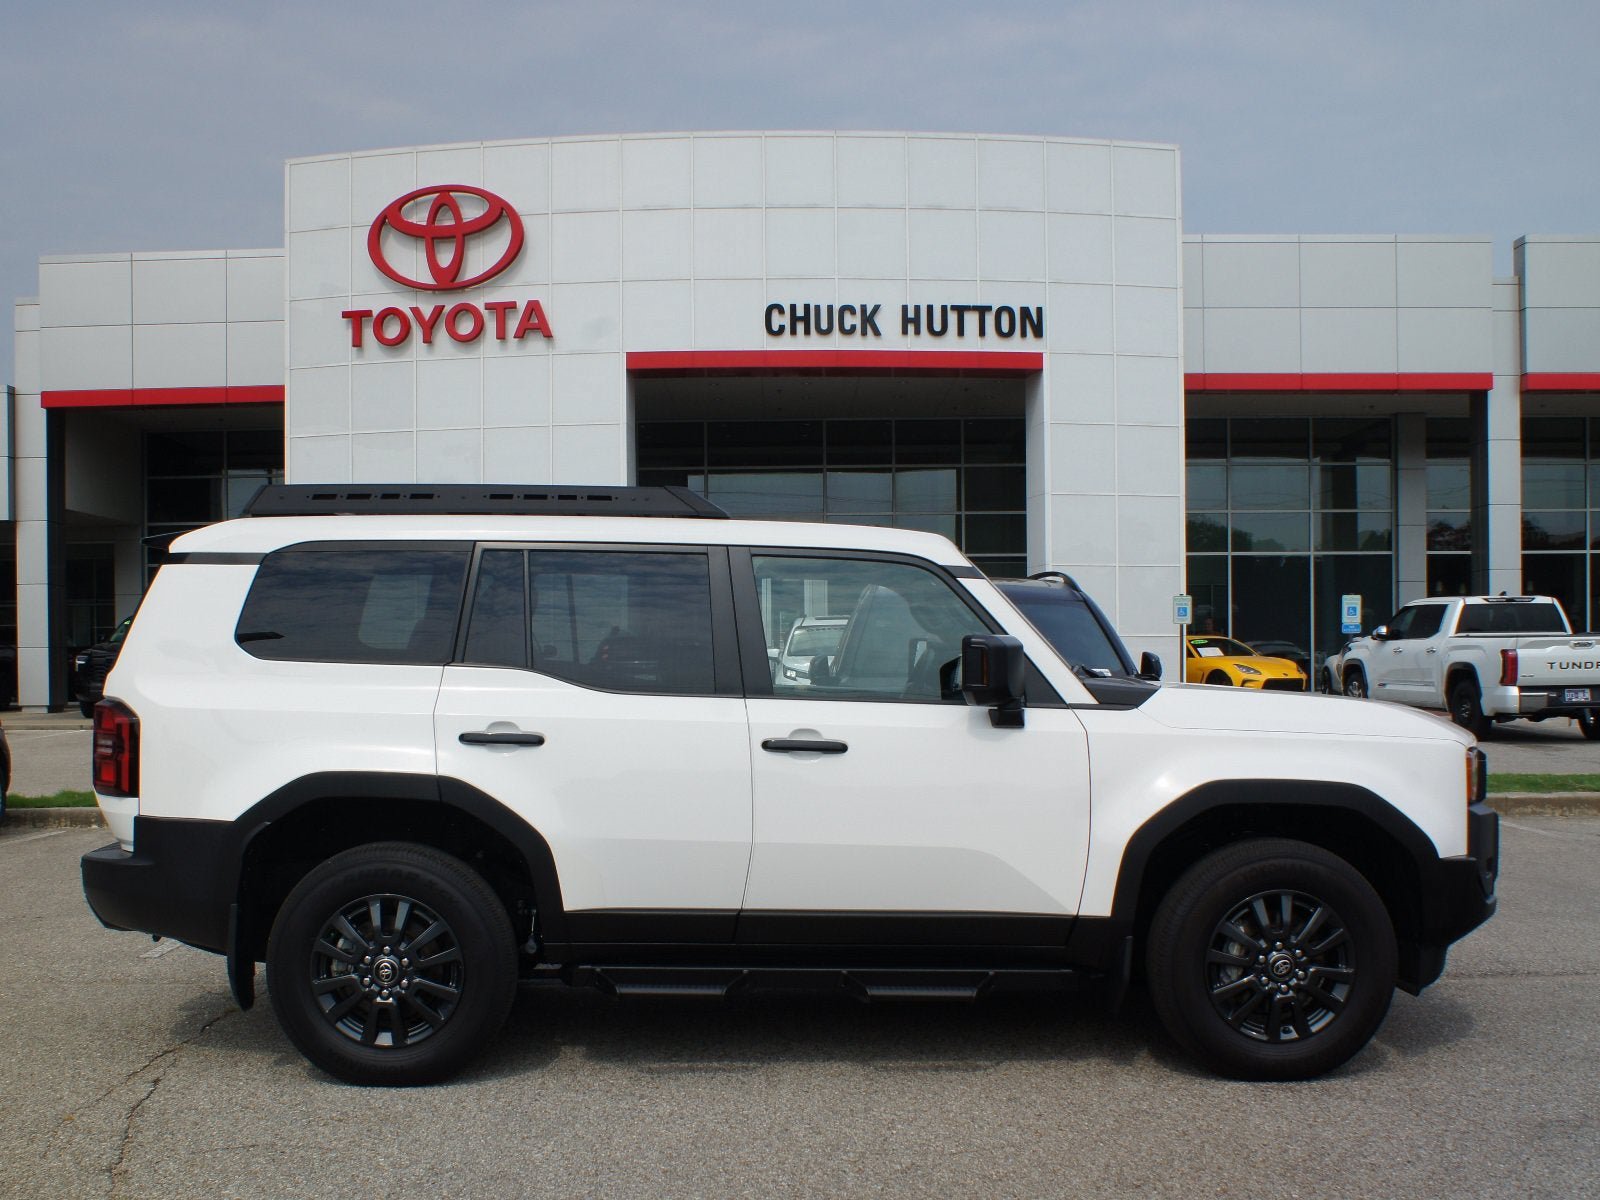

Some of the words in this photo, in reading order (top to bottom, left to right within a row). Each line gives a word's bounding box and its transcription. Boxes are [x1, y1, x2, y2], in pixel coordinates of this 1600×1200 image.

[341, 299, 553, 348] TOYOTA
[764, 303, 882, 337] CHUCK
[901, 304, 1044, 338] HUTTON
